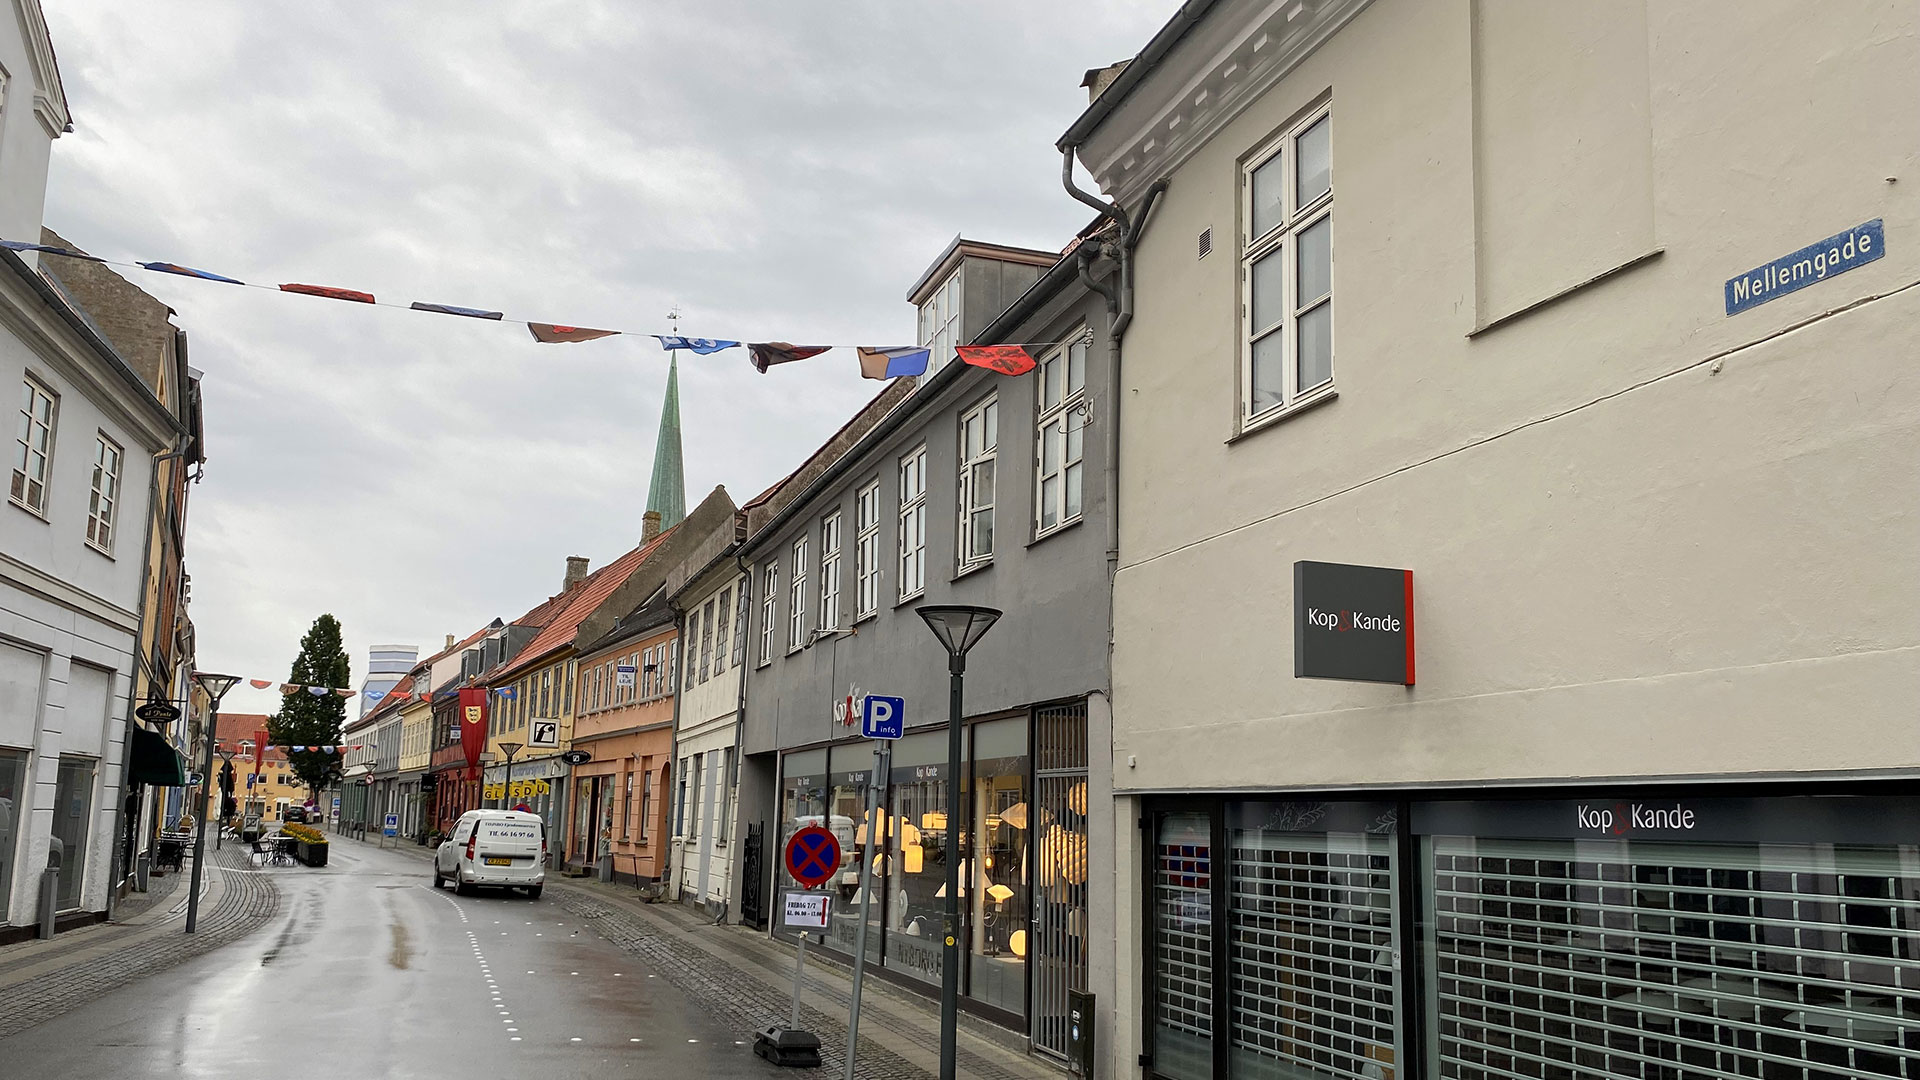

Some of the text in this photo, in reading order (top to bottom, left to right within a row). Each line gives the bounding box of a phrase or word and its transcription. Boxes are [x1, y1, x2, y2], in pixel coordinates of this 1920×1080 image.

[1733, 232, 1872, 305] Mellemgade
[1308, 607, 1339, 631] Kop
[1352, 611, 1401, 632] Kande
[869, 700, 893, 732] P
[880, 726, 896, 734] info
[1577, 805, 1613, 834] Kop
[1631, 803, 1695, 829] Kande
